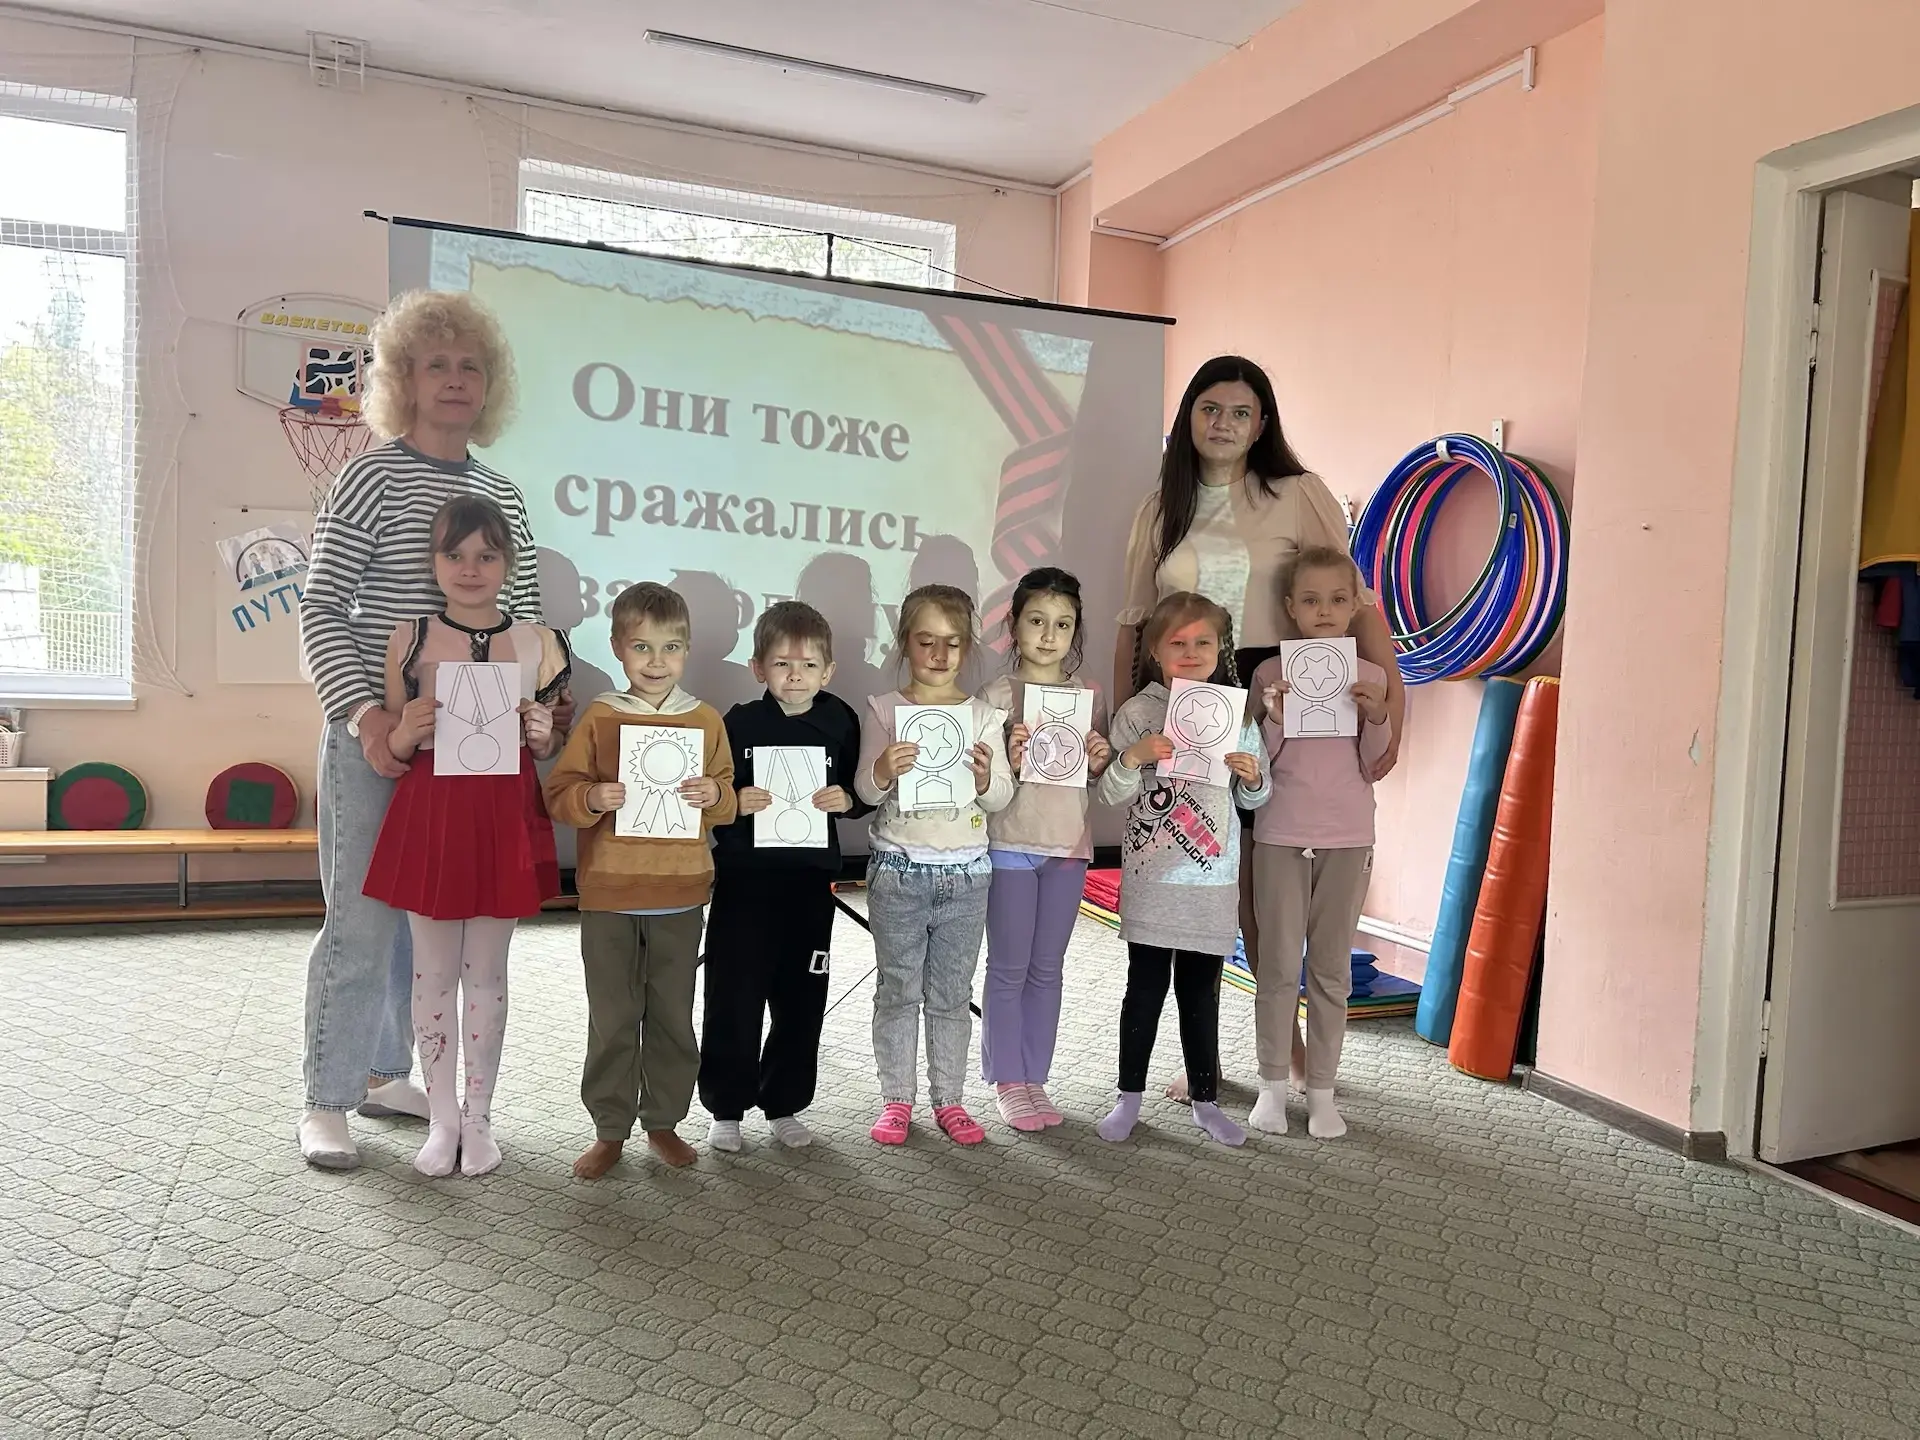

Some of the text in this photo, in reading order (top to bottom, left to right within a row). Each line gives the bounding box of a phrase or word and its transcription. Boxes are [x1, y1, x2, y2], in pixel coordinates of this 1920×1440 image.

[260, 312, 369, 335] BASKETBA
[572, 362, 911, 462] Они тоже
[1180, 791, 1218, 834] ARE YOU
[1162, 818, 1212, 873] ENOUGH?
